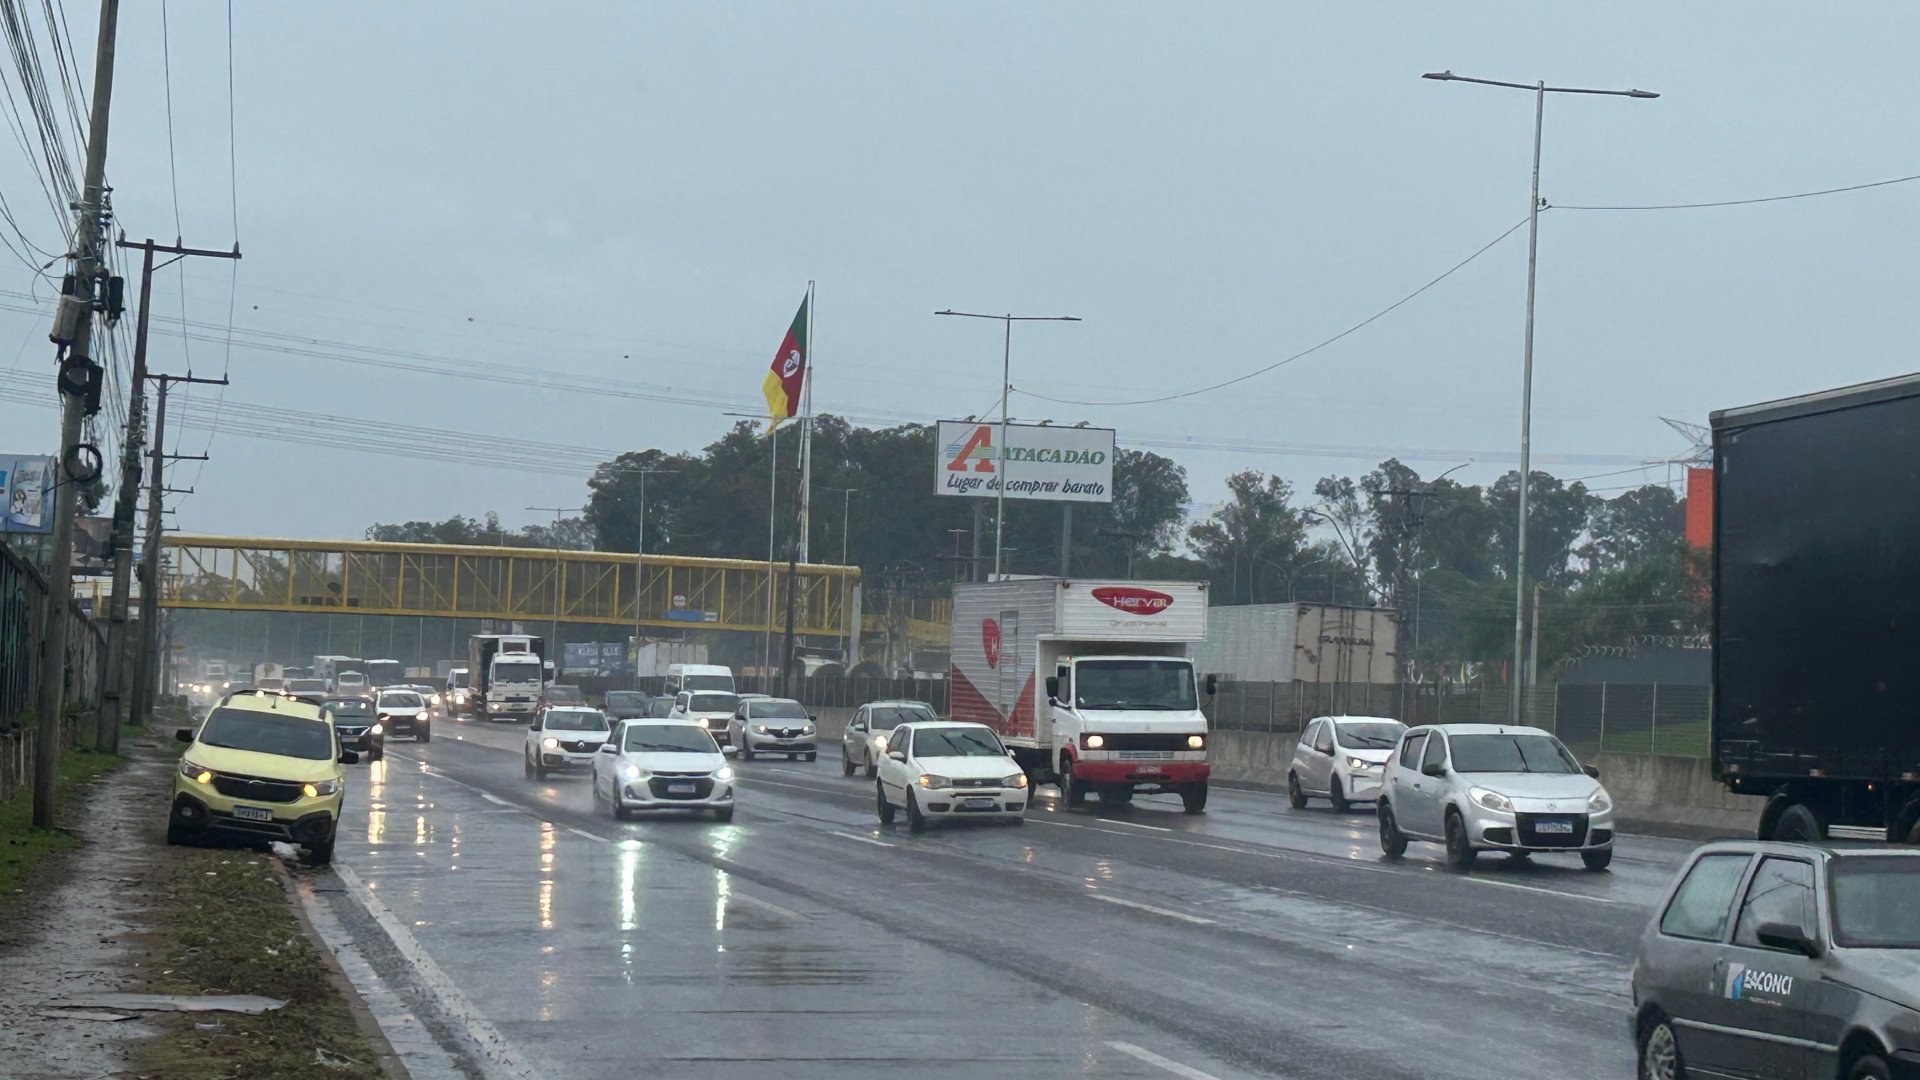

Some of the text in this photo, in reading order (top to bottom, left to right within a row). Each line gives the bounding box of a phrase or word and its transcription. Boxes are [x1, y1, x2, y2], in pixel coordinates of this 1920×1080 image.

[947, 473, 1105, 496] Lugar de comprar barato
